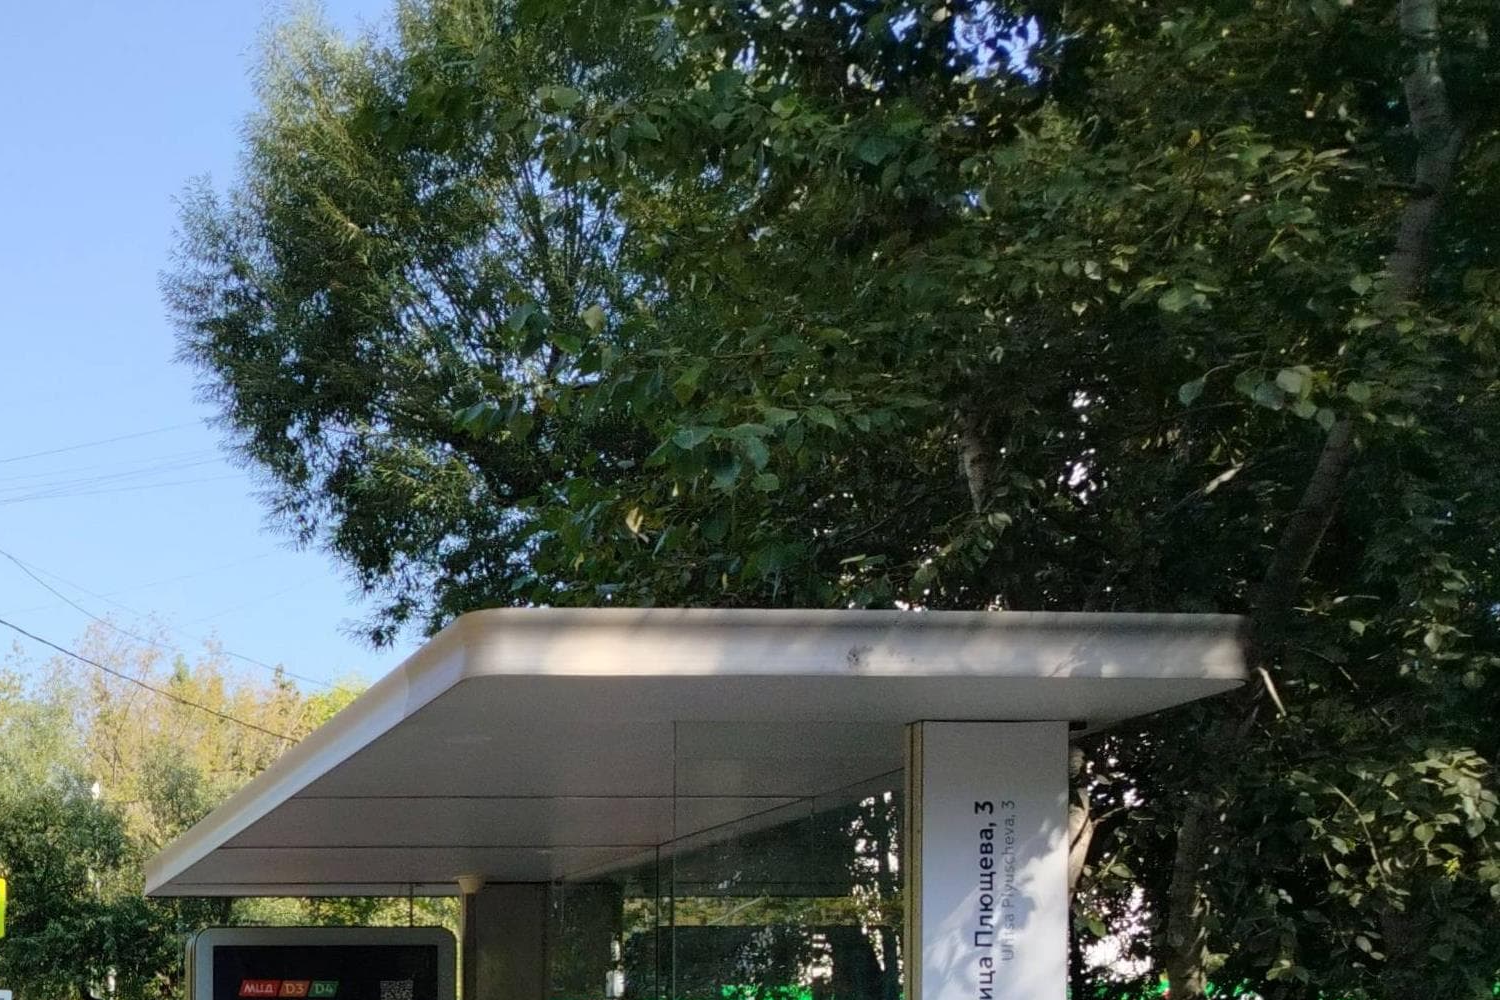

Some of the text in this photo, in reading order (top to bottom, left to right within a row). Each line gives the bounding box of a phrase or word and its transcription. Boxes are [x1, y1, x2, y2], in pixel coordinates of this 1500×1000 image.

[974, 800, 994, 815] 3
[1001, 800, 1015, 810] 3
[1002, 814, 1017, 909] Plyuscheva,
[974, 821, 997, 947] Плющева,
[243, 982, 334, 994] МЦД D3 D4
